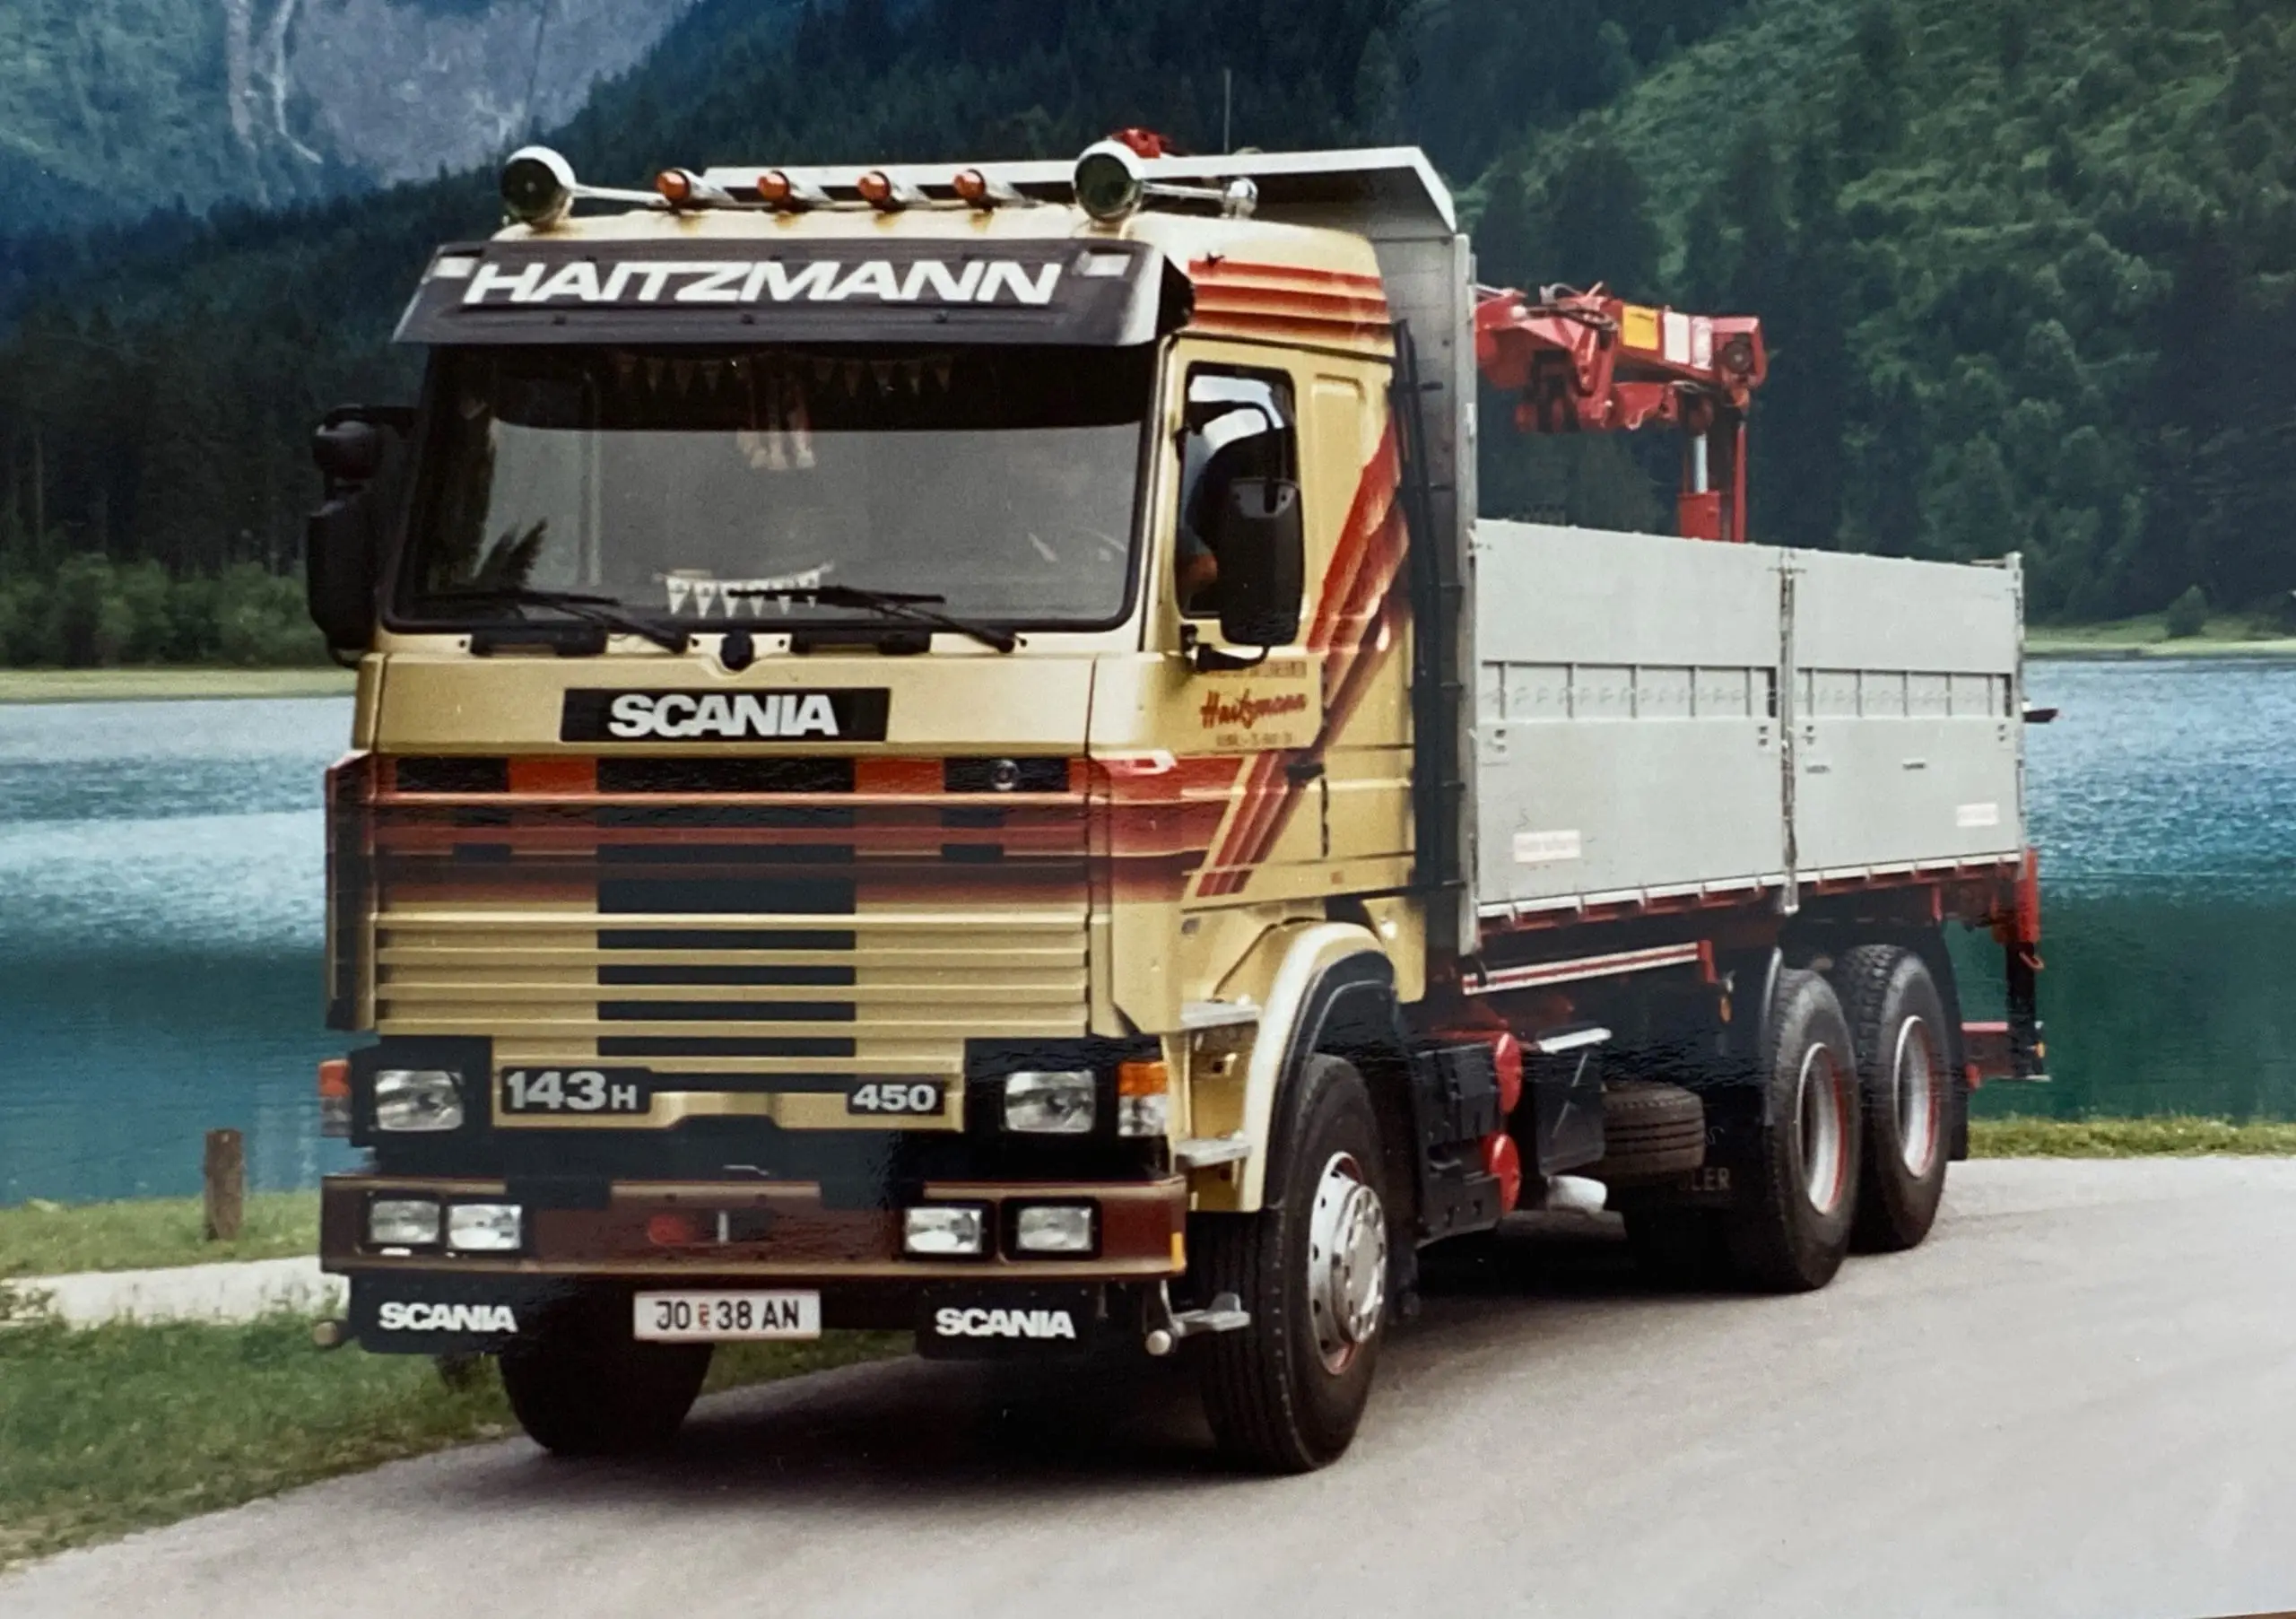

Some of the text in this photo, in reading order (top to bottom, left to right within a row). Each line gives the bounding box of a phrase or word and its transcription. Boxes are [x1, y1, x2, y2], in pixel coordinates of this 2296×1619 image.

[462, 259, 1063, 305] HAITZMANN
[608, 694, 839, 737] SCANIA
[852, 1084, 936, 1111] 450
[378, 1301, 517, 1333] SCANIA
[656, 1300, 799, 1330] JO 38 AN
[935, 1308, 1076, 1339] SCANIA
